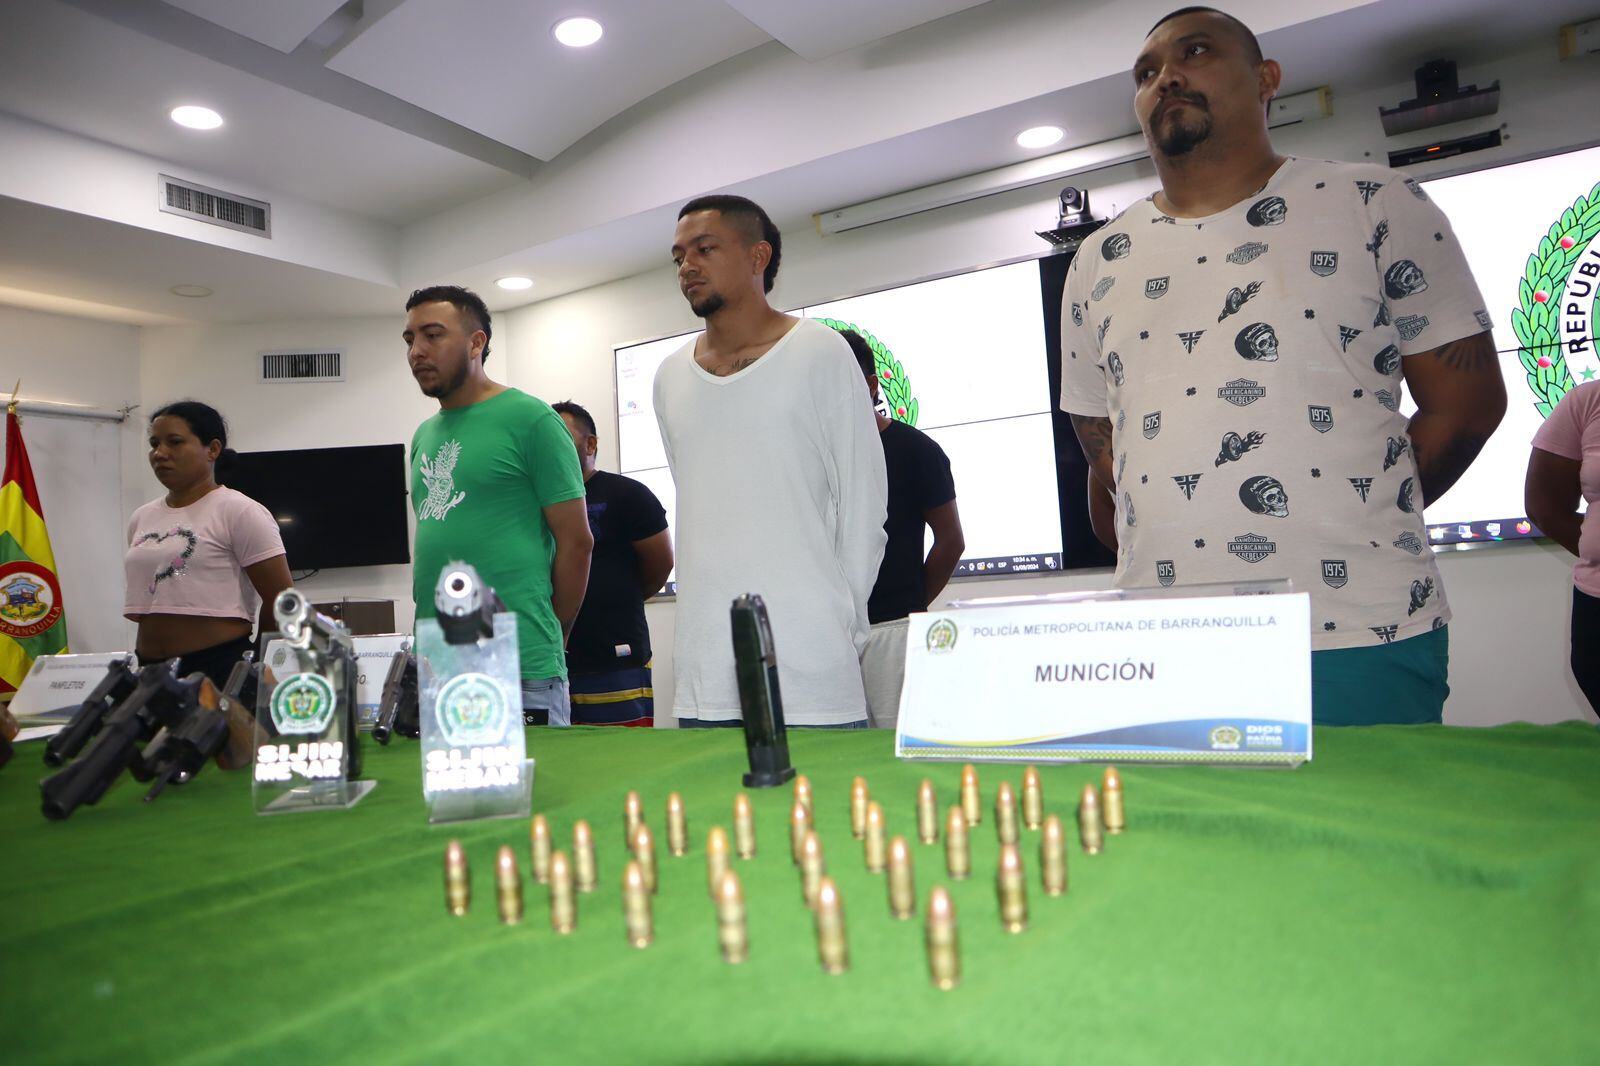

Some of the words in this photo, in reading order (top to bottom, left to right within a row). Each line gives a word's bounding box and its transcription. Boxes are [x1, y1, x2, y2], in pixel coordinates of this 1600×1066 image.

[1313, 254, 1335, 267] 1975
[1147, 280, 1167, 292] 1975
[1144, 414, 1159, 430] 1975
[1311, 408, 1331, 422] 1975
[1159, 563, 1173, 577] 1975
[1324, 563, 1345, 577] 1975
[973, 623, 1020, 637] POLICÍA
[1024, 621, 1133, 635] METROPOLITANA
[1138, 619, 1157, 630] DE
[1161, 615, 1277, 630] BARRANQUILLA
[1035, 657, 1155, 682] MUNICIÓN
[1246, 725, 1283, 734] DIOS
[257, 741, 343, 763] SIJIN
